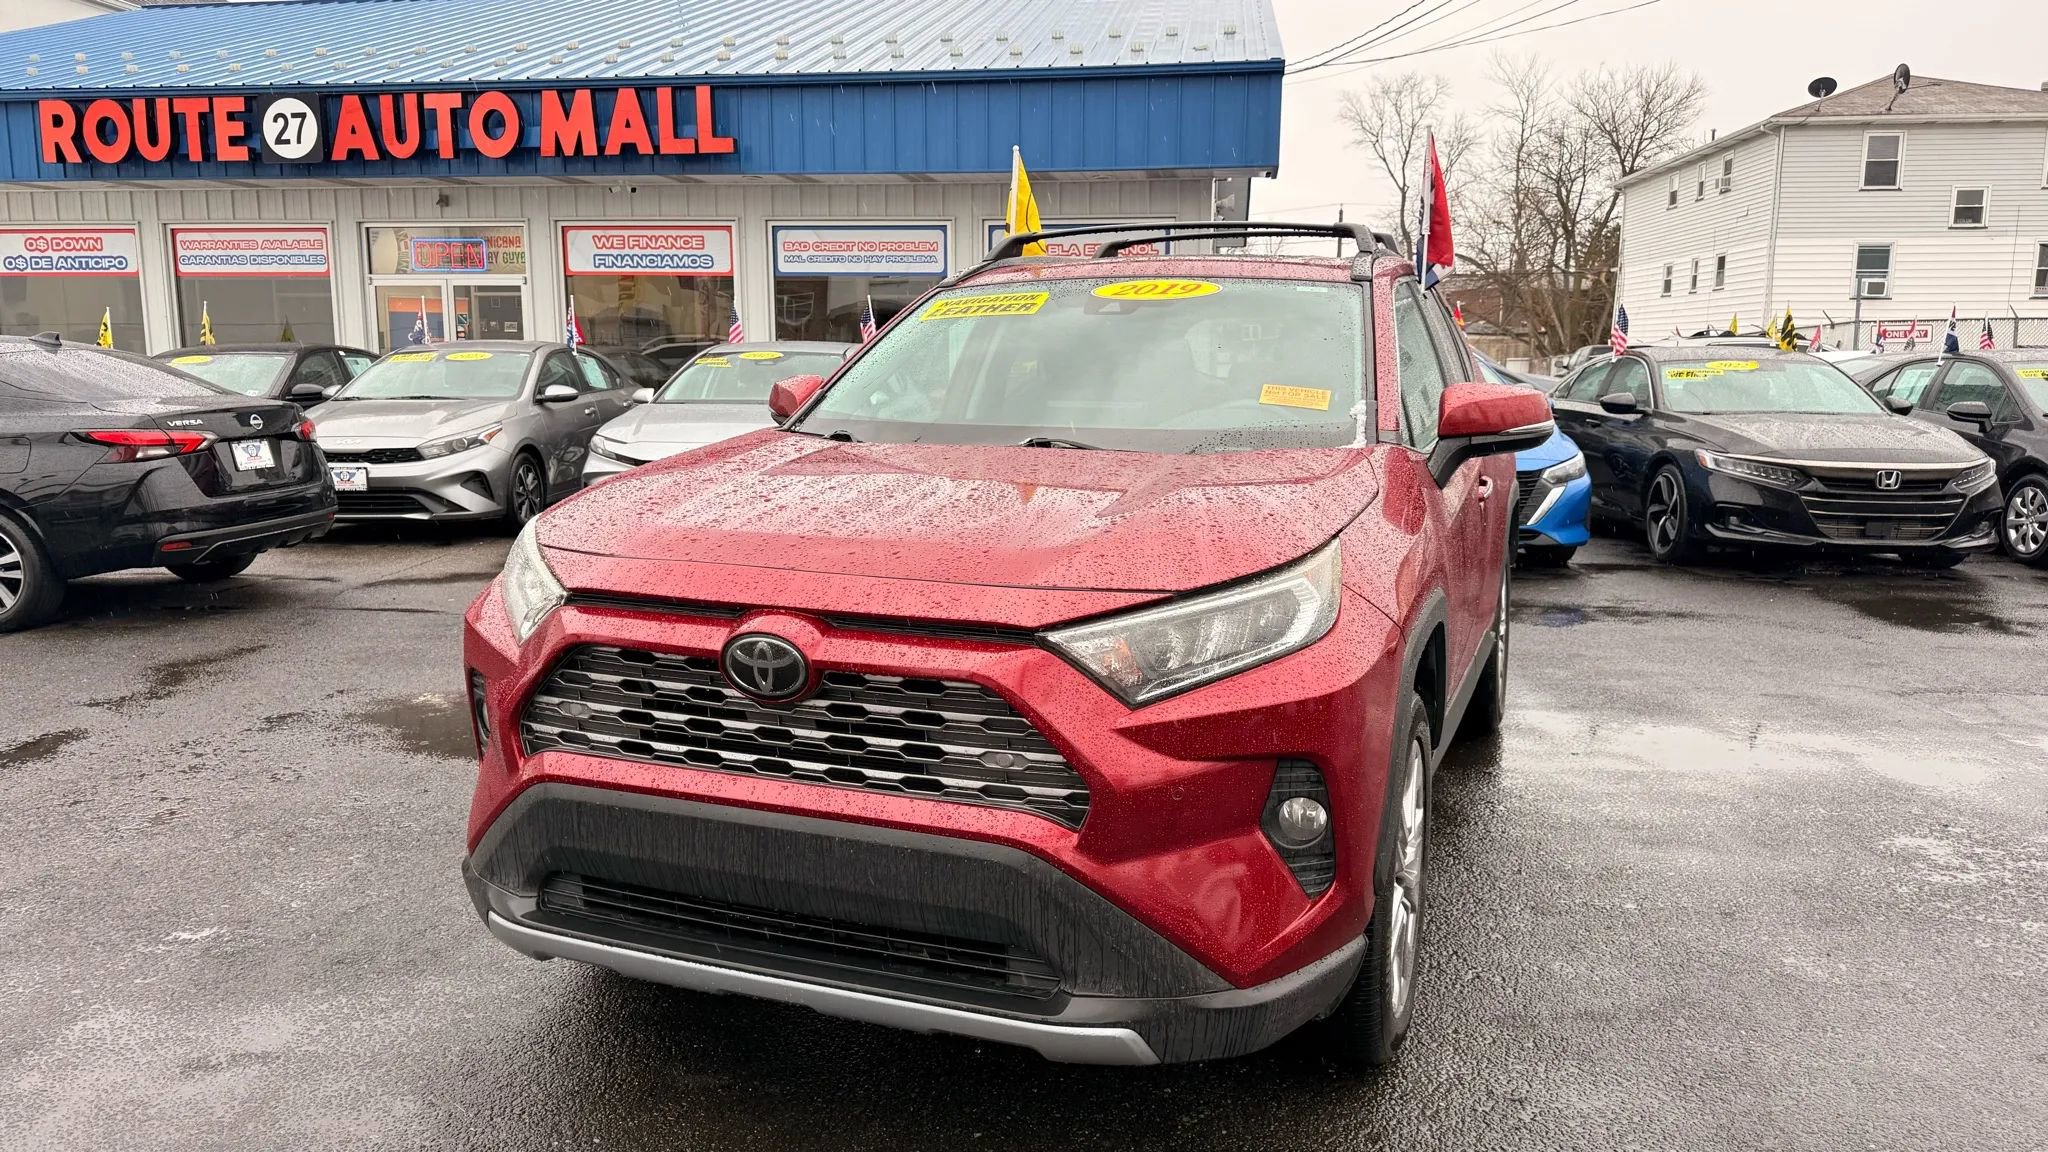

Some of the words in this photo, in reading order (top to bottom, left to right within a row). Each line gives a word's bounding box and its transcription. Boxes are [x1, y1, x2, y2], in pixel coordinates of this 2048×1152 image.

[38, 95, 249, 164] ROUTE
[272, 112, 307, 145] 27
[331, 90, 520, 161] AUTO
[540, 85, 735, 158] MALL
[51, 237, 103, 252] DOWN
[180, 239, 258, 250] WARRANTIES
[261, 239, 323, 249] AVAILABLE
[592, 235, 625, 249] WE
[628, 235, 704, 250] FINANCE
[783, 241, 810, 252] BAD
[812, 241, 856, 252] CREDIT
[858, 241, 877, 252] NO
[879, 241, 938, 252] PROBLEM
[1047, 243, 1081, 256] BLA
[179, 254, 248, 265] GARANTIAS
[250, 254, 326, 265] DISPONIBLES
[414, 242, 484, 269] OPEN
[593, 254, 714, 268] FINANCIAMOS
[784, 255, 805, 263] MAL
[807, 255, 846, 263] CREDITO
[848, 255, 862, 263] NO
[864, 255, 884, 263] HAY
[885, 255, 937, 263] PROBLEMA
[29, 256, 53, 270] DE
[55, 256, 128, 270] ANTICIPO
[1112, 283, 1201, 296] 2019
[939, 294, 1043, 308] NAVIGATION
[928, 303, 1038, 318] LEATHER
[167, 419, 203, 427] VERSA
